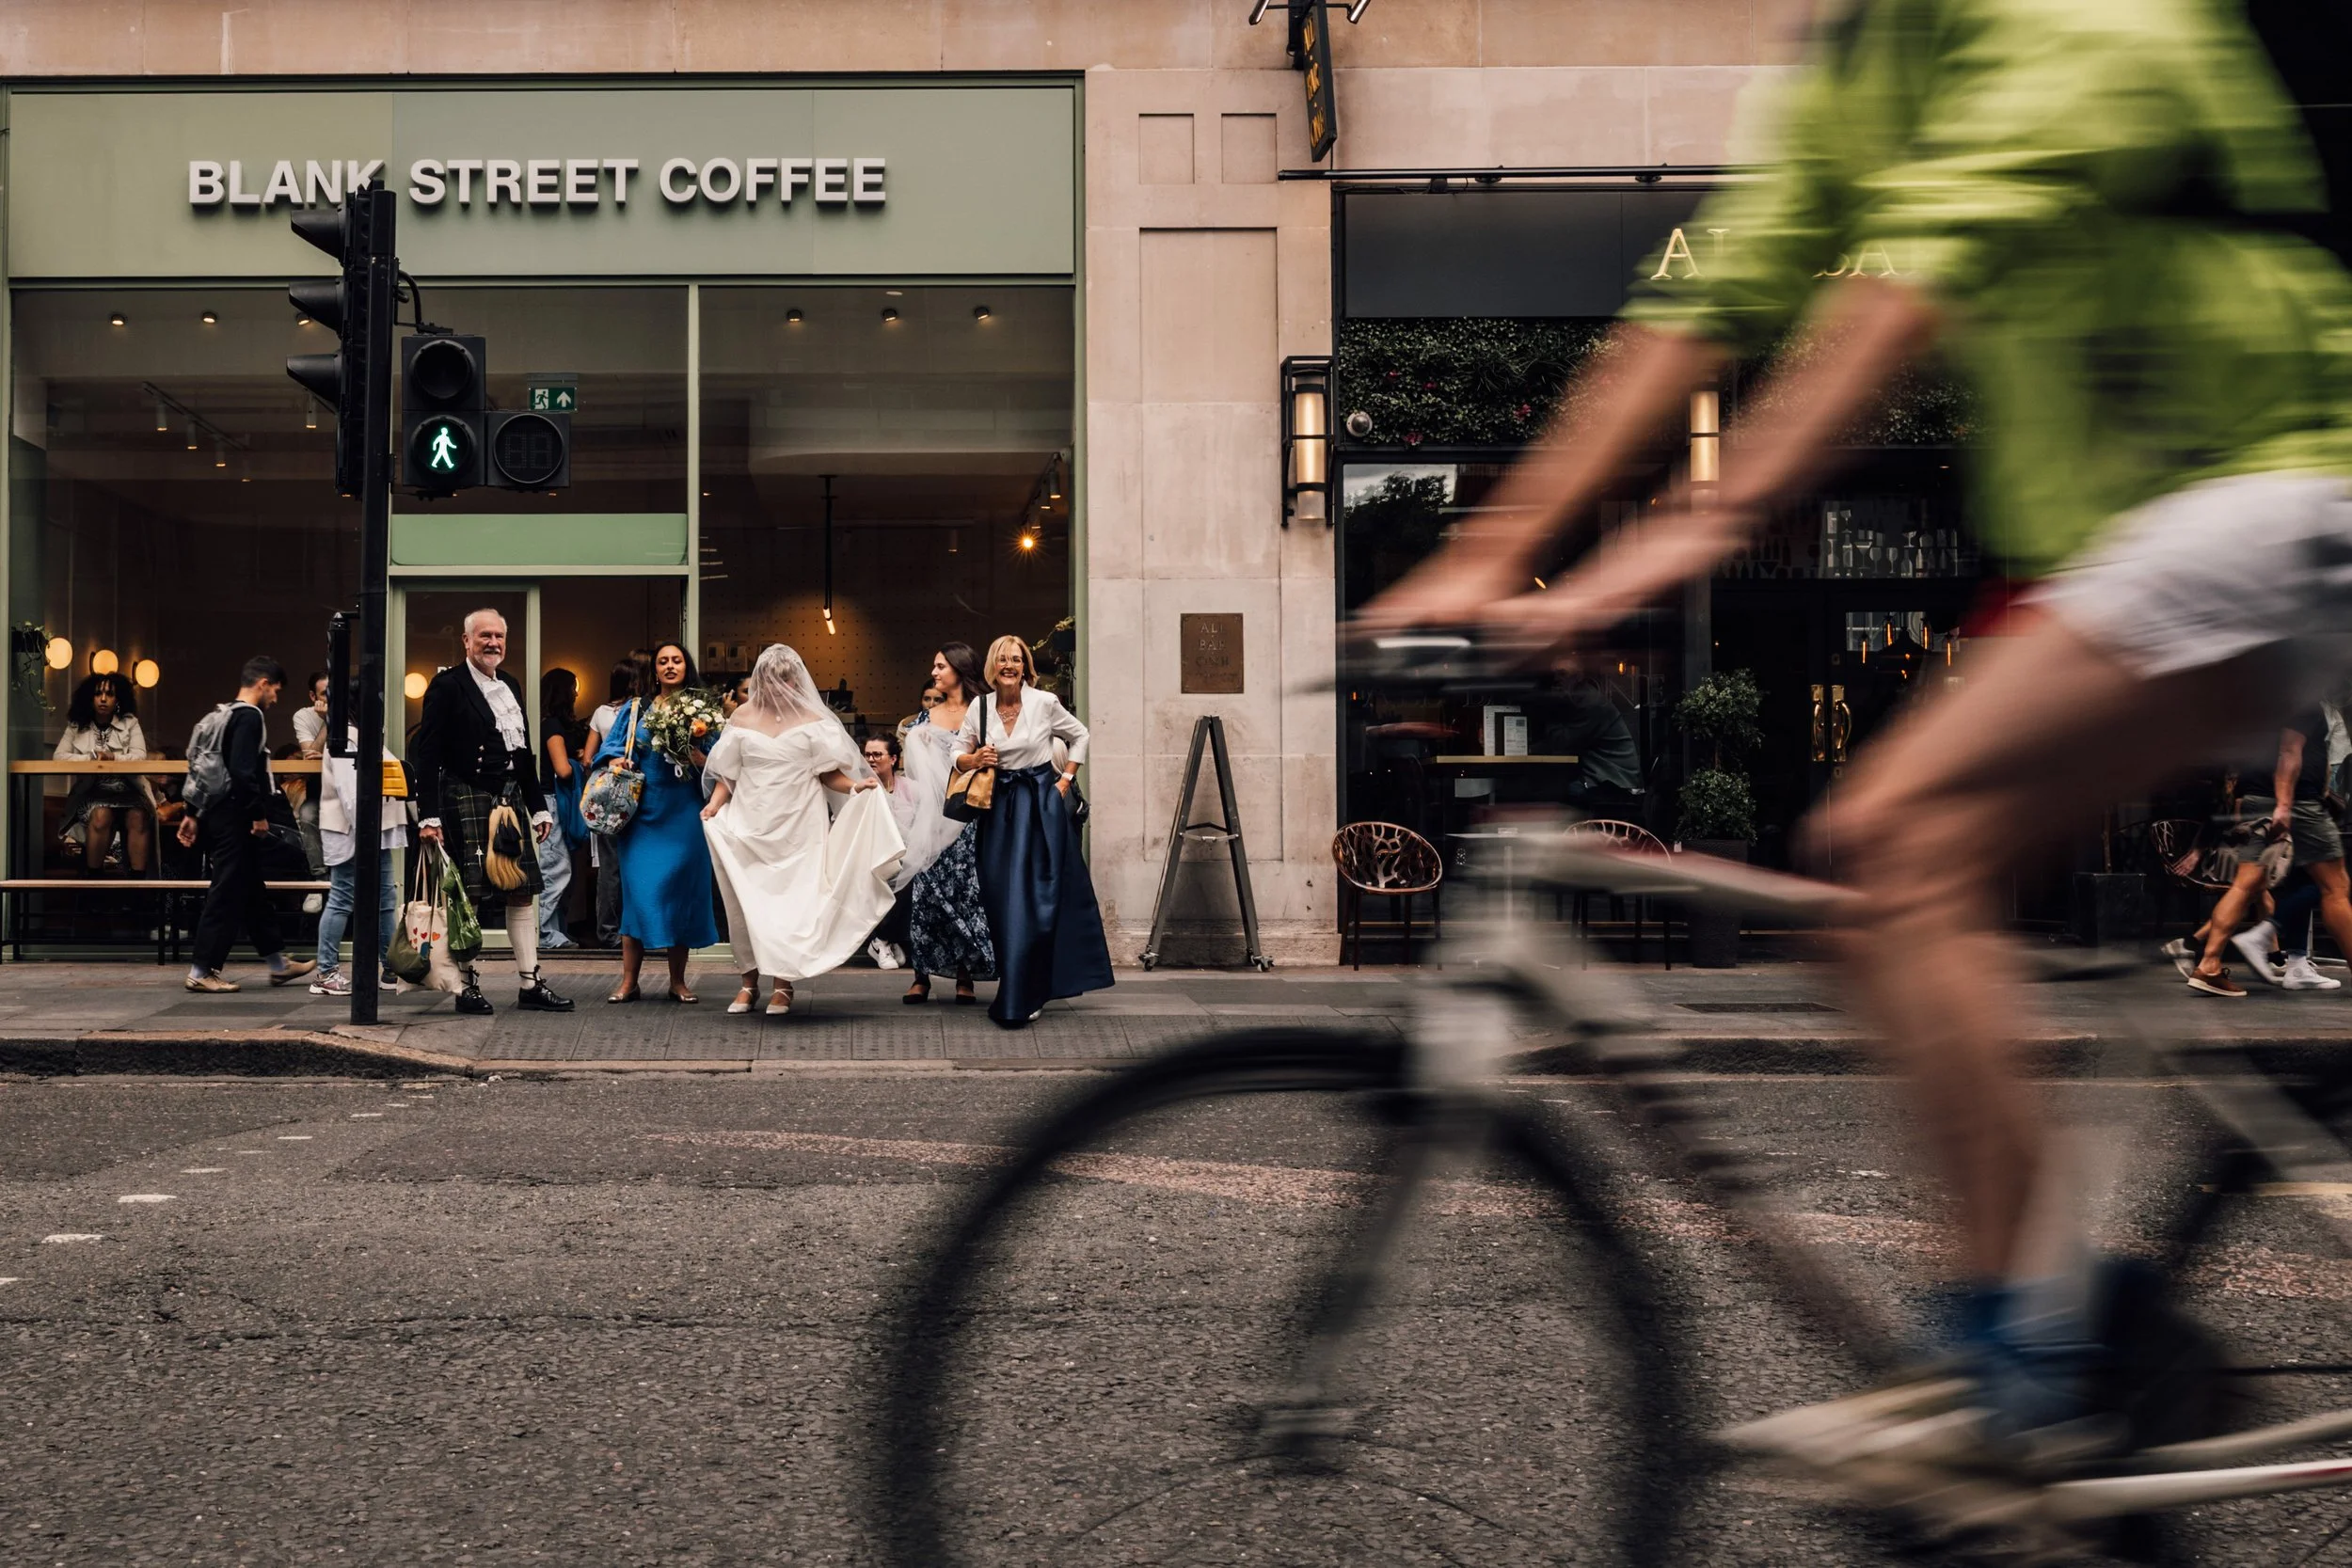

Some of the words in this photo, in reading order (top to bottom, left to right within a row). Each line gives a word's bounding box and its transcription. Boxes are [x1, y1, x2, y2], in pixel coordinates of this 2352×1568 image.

[189, 159, 385, 205] BLANK
[408, 158, 640, 205] STREET
[660, 157, 886, 204] COFFEE
